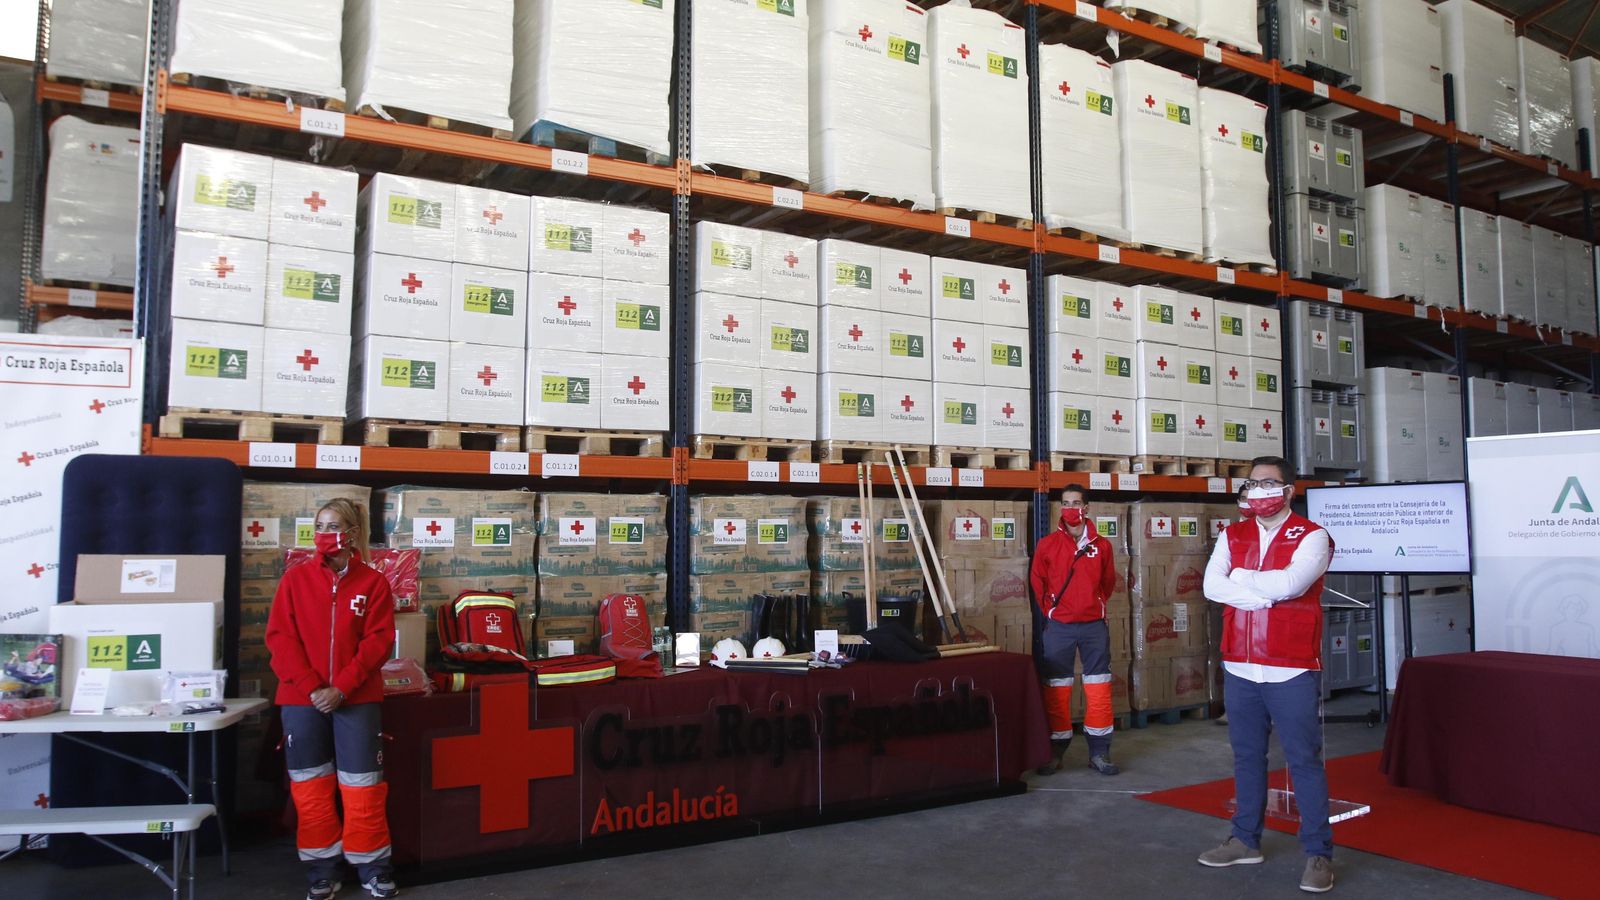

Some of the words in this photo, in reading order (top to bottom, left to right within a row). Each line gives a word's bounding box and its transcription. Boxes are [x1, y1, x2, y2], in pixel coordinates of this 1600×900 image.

[890, 43, 903, 51] 112
[392, 203, 414, 213] 112
[549, 230, 568, 239] 112
[287, 276, 311, 287] 112
[399, 296, 411, 304] Roja
[468, 292, 488, 301] 112
[619, 310, 638, 318] 112
[556, 318, 567, 326] Roja
[774, 333, 790, 341] 112
[190, 354, 216, 364] 112
[5, 356, 35, 369] Cruz
[40, 357, 67, 373] Roja
[70, 359, 124, 374] Española
[385, 366, 408, 375] 112
[277, 372, 292, 380] Cruz
[293, 374, 307, 382] Roja
[545, 383, 565, 392] 112
[476, 388, 488, 397] Roja
[53, 447, 69, 457] Roja
[70, 440, 99, 452] Española
[12, 491, 42, 503] Española
[1400, 500, 1430, 508] Consejería
[1415, 518, 1441, 526] Española
[1528, 518, 1555, 527] Junta
[8, 607, 39, 619] Española
[92, 644, 123, 656] 112
[590, 712, 702, 770] Cruz
[714, 701, 816, 769] Roja
[825, 683, 990, 756] Española
[591, 784, 739, 835] Andalucía
